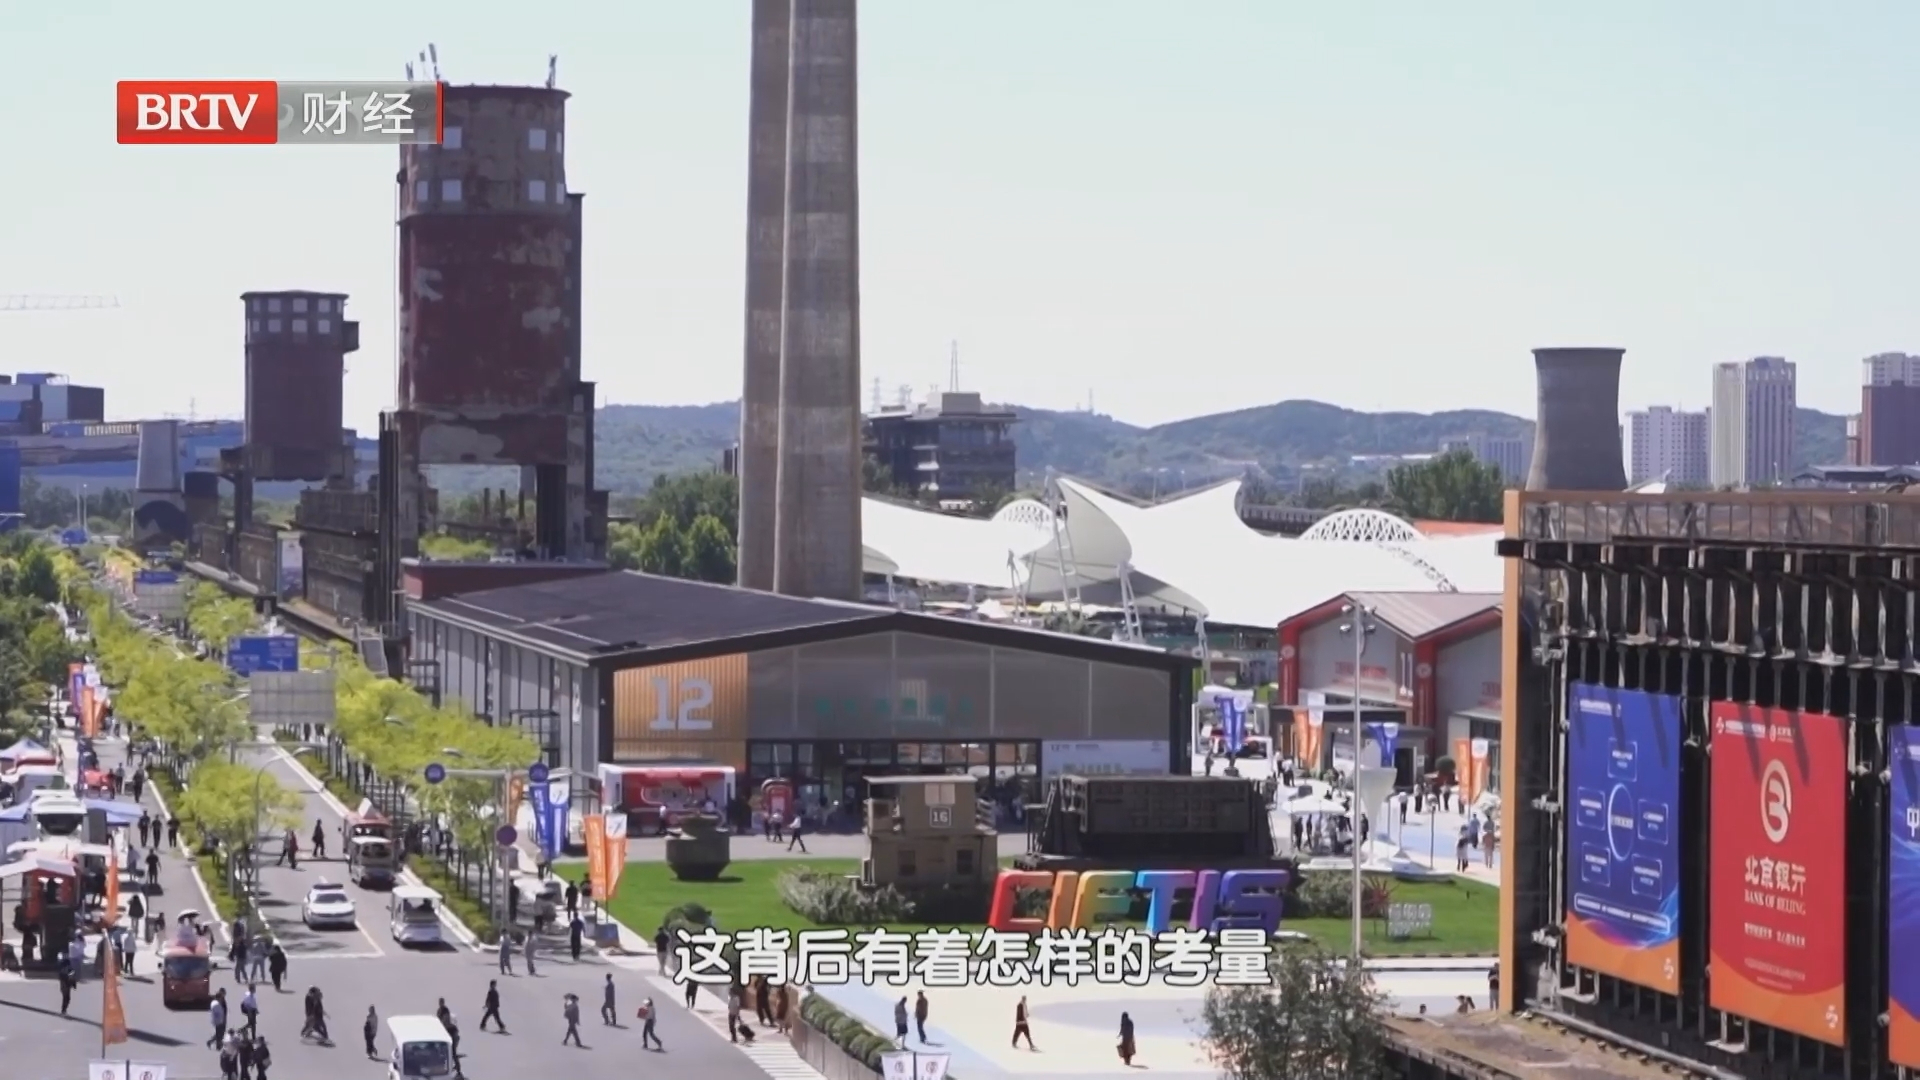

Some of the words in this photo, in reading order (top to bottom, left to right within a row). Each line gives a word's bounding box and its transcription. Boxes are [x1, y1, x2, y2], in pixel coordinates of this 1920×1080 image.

[650, 677, 713, 729] 12
[933, 811, 948, 822] 16
[1745, 855, 1806, 897] 北京银行
[989, 869, 1291, 938] CIFTIS
